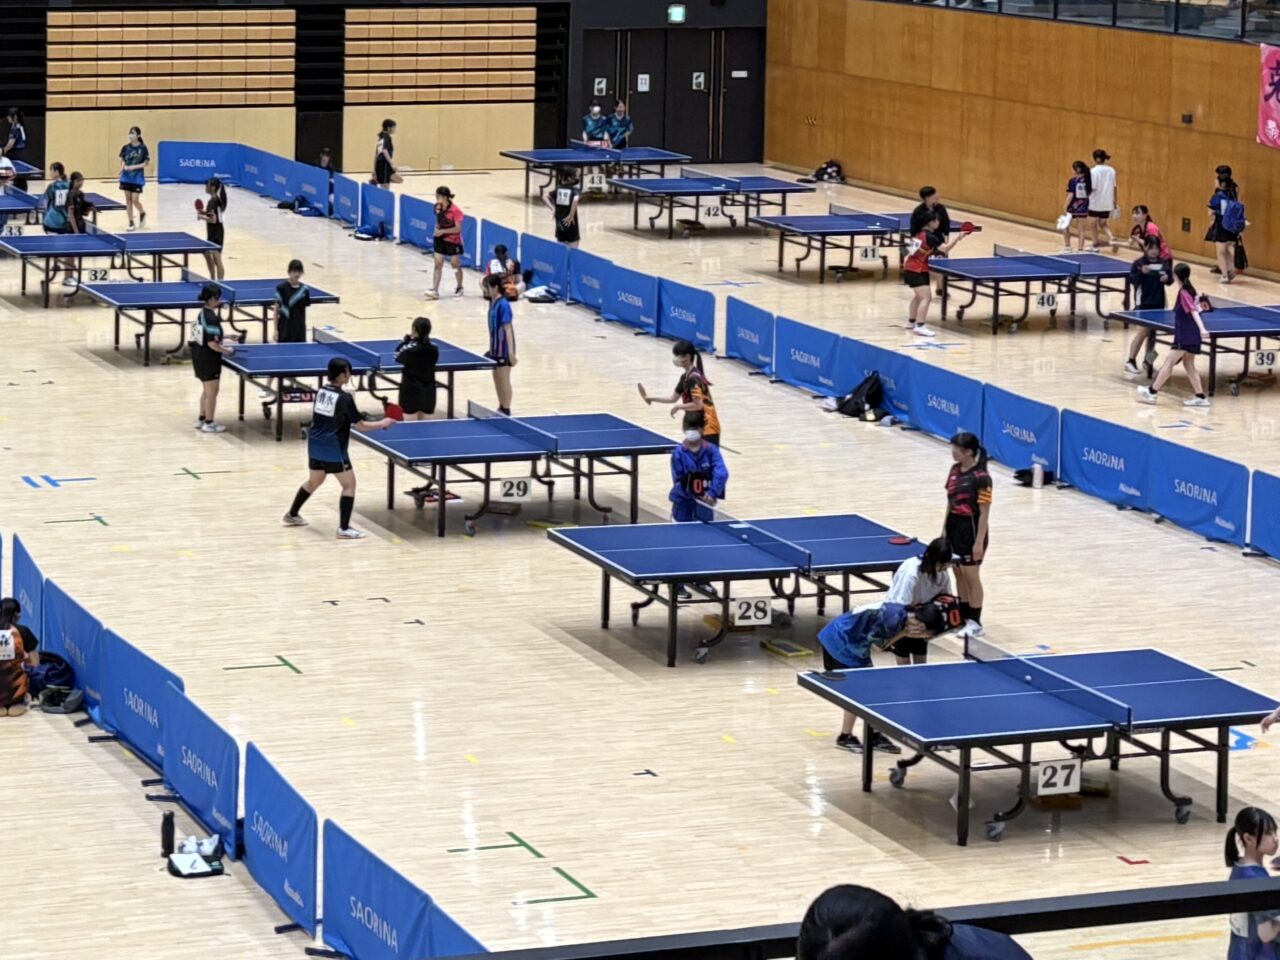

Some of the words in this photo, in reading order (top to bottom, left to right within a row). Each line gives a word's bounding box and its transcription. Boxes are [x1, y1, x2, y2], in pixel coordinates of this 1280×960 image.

[179, 158, 216, 168] SAORINA
[588, 175, 603, 185] 43
[704, 206, 720, 217] 42
[861, 248, 877, 259] 41
[90, 269, 108, 280] 32
[1037, 295, 1055, 307] 40
[1255, 352, 1276, 366] 39
[927, 394, 960, 417] SAORINA
[1002, 420, 1037, 445] SAORINA
[1083, 447, 1125, 472] SAORINA
[502, 480, 528, 497] 29
[1174, 479, 1218, 507] SAORINA
[738, 600, 767, 620] 28
[124, 688, 159, 729] SAORINA
[181, 745, 218, 791] SAORINA
[1041, 764, 1076, 789] 27
[252, 811, 289, 864] SAORINA
[350, 895, 399, 954] SAORINA
